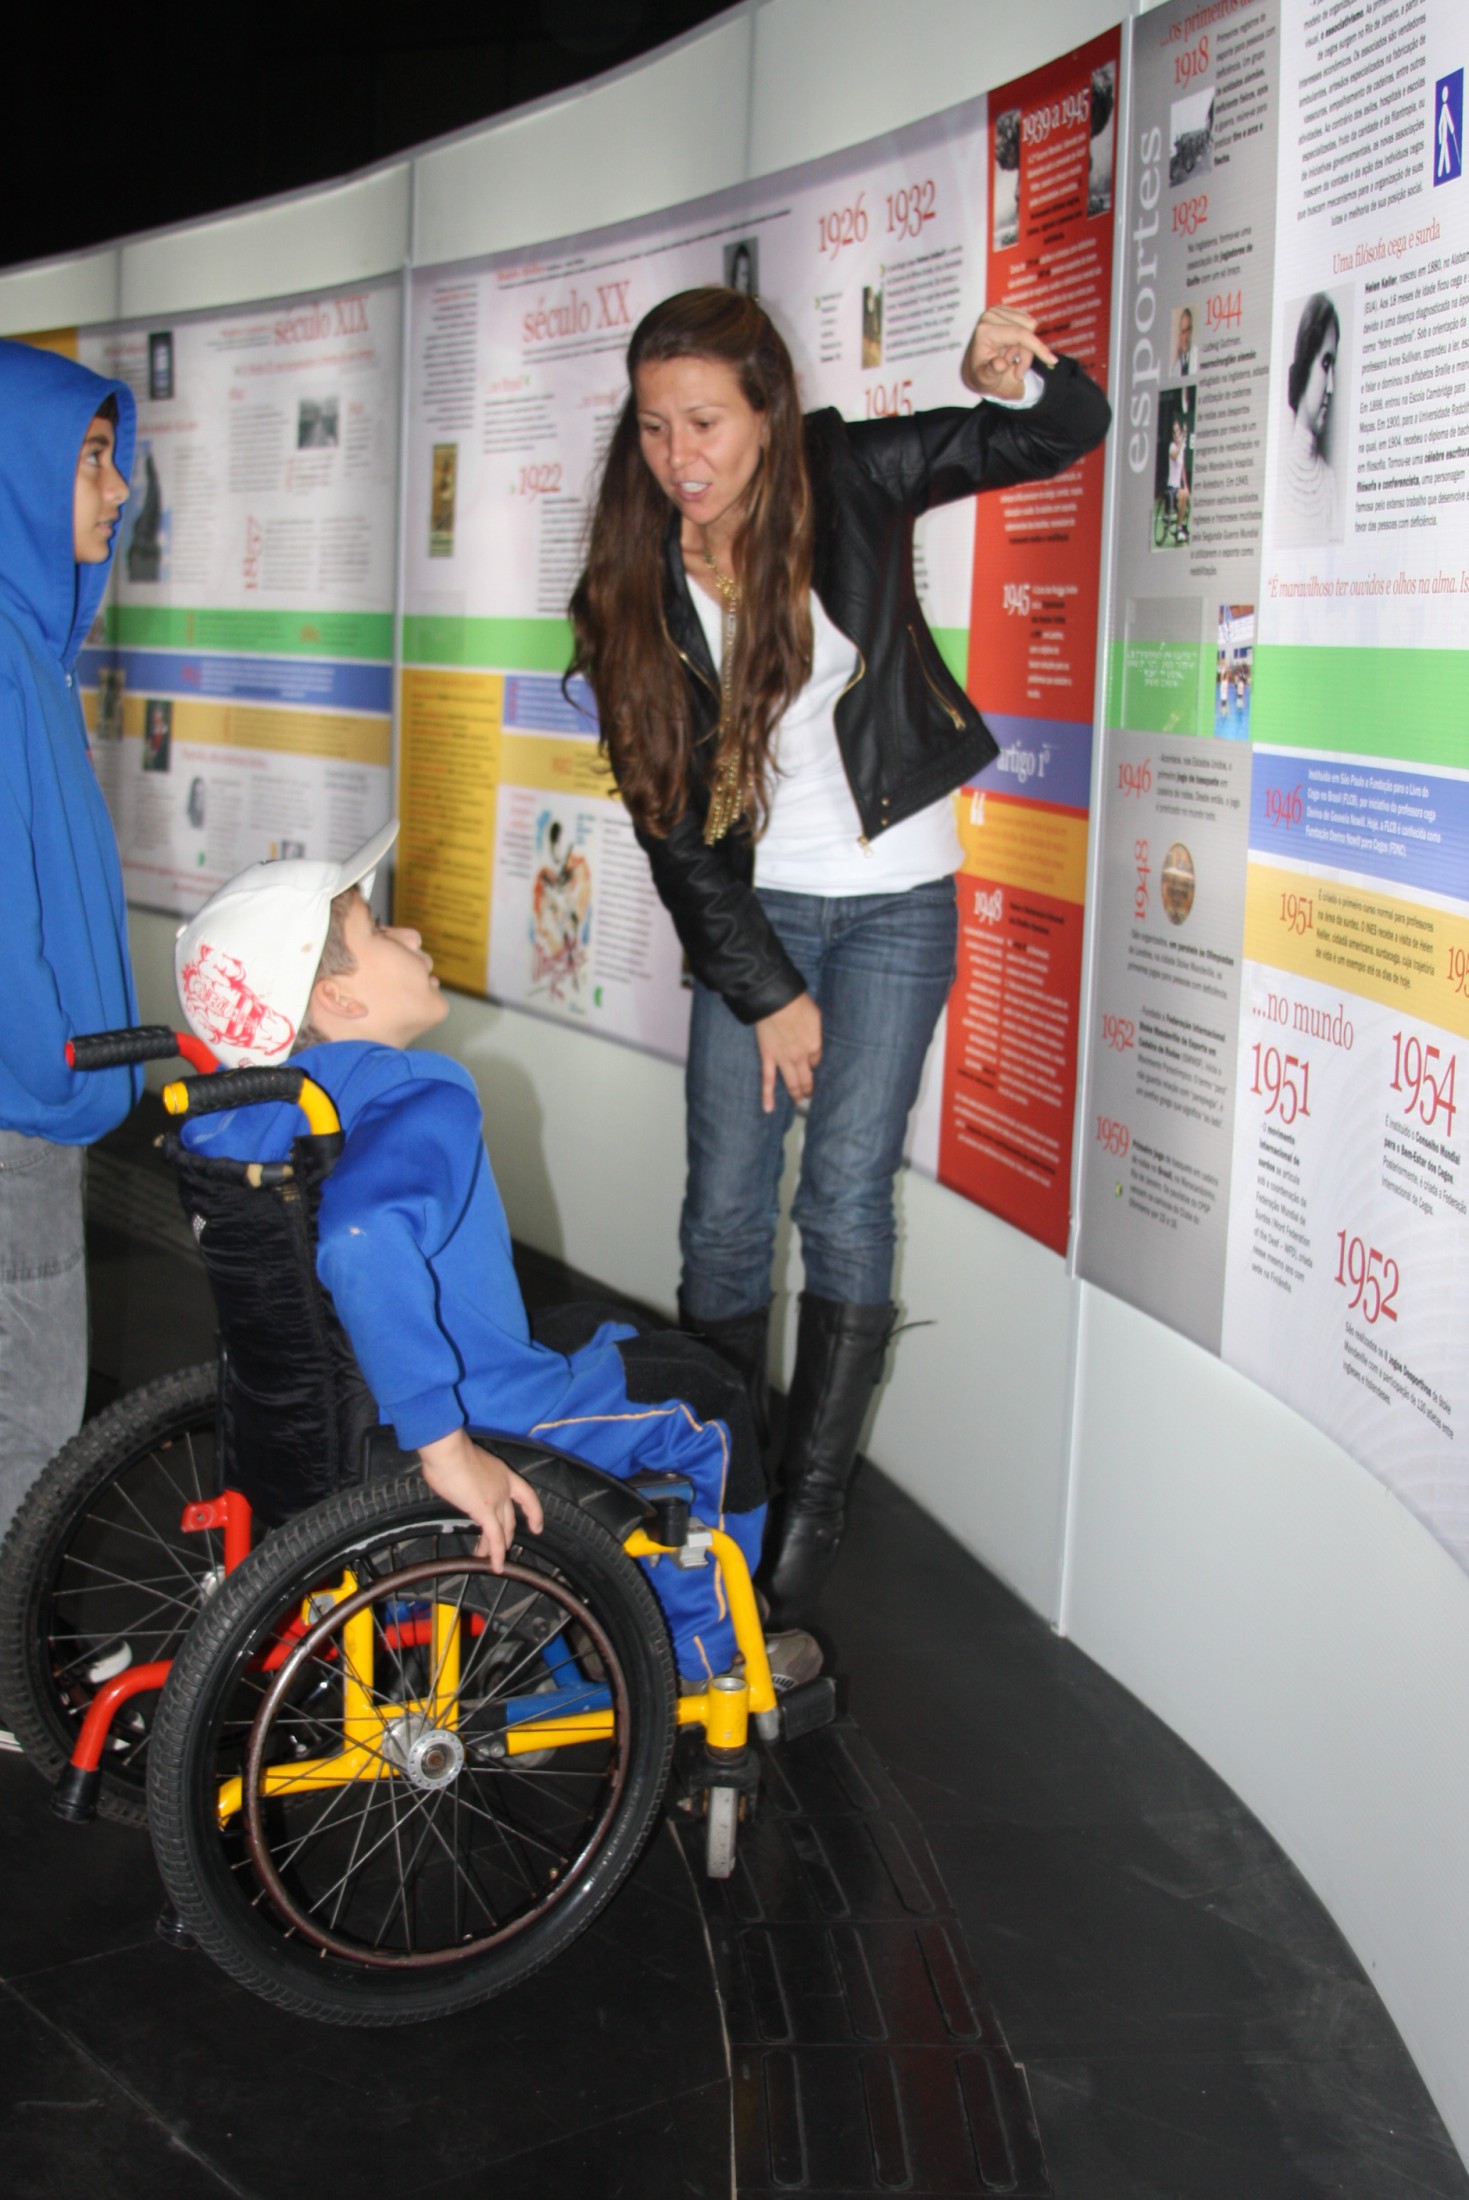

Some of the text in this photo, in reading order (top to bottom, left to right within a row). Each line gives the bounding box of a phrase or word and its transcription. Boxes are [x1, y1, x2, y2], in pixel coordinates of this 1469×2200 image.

[1174, 35, 1209, 89] 1918
[1062, 88, 1090, 129] 1945
[818, 192, 867, 261] 1926
[886, 180, 936, 241] 1932
[1172, 194, 1209, 238] 1932
[1333, 217, 1440, 274] Uma filósofa cega e surda
[1128, 125, 1162, 474] esportes
[1365, 280, 1380, 295] Helen
[1398, 291, 1414, 304] meses
[1415, 287, 1421, 299] de
[1422, 283, 1436, 297] idade
[274, 303, 332, 345] século
[335, 294, 370, 336] XIX
[523, 280, 632, 342] século XX
[1205, 290, 1242, 333] 1944
[519, 464, 562, 503] 1922
[1003, 583, 1030, 616] 1945
[1280, 576, 1333, 597] maravilhoso
[1335, 579, 1348, 596] ter
[1350, 573, 1383, 596] ouvidos
[1386, 581, 1391, 594] e
[1393, 571, 1416, 594] olhos
[1418, 578, 1430, 594] na
[1432, 570, 1457, 593] alma.
[997, 740, 1035, 783] artigo
[1117, 758, 1151, 800] 1946
[1265, 784, 1303, 830] 1946
[1135, 838, 1151, 922] 1948
[973, 889, 1003, 925] 1948
[1280, 892, 1313, 935] 1951
[1102, 1012, 1135, 1052] 1952
[1293, 1004, 1354, 1051] mundo
[1250, 1041, 1310, 1125] 1951
[1390, 1030, 1457, 1137] 1954
[1096, 1114, 1130, 1158] 1959
[1334, 1229, 1399, 1324] 1952
